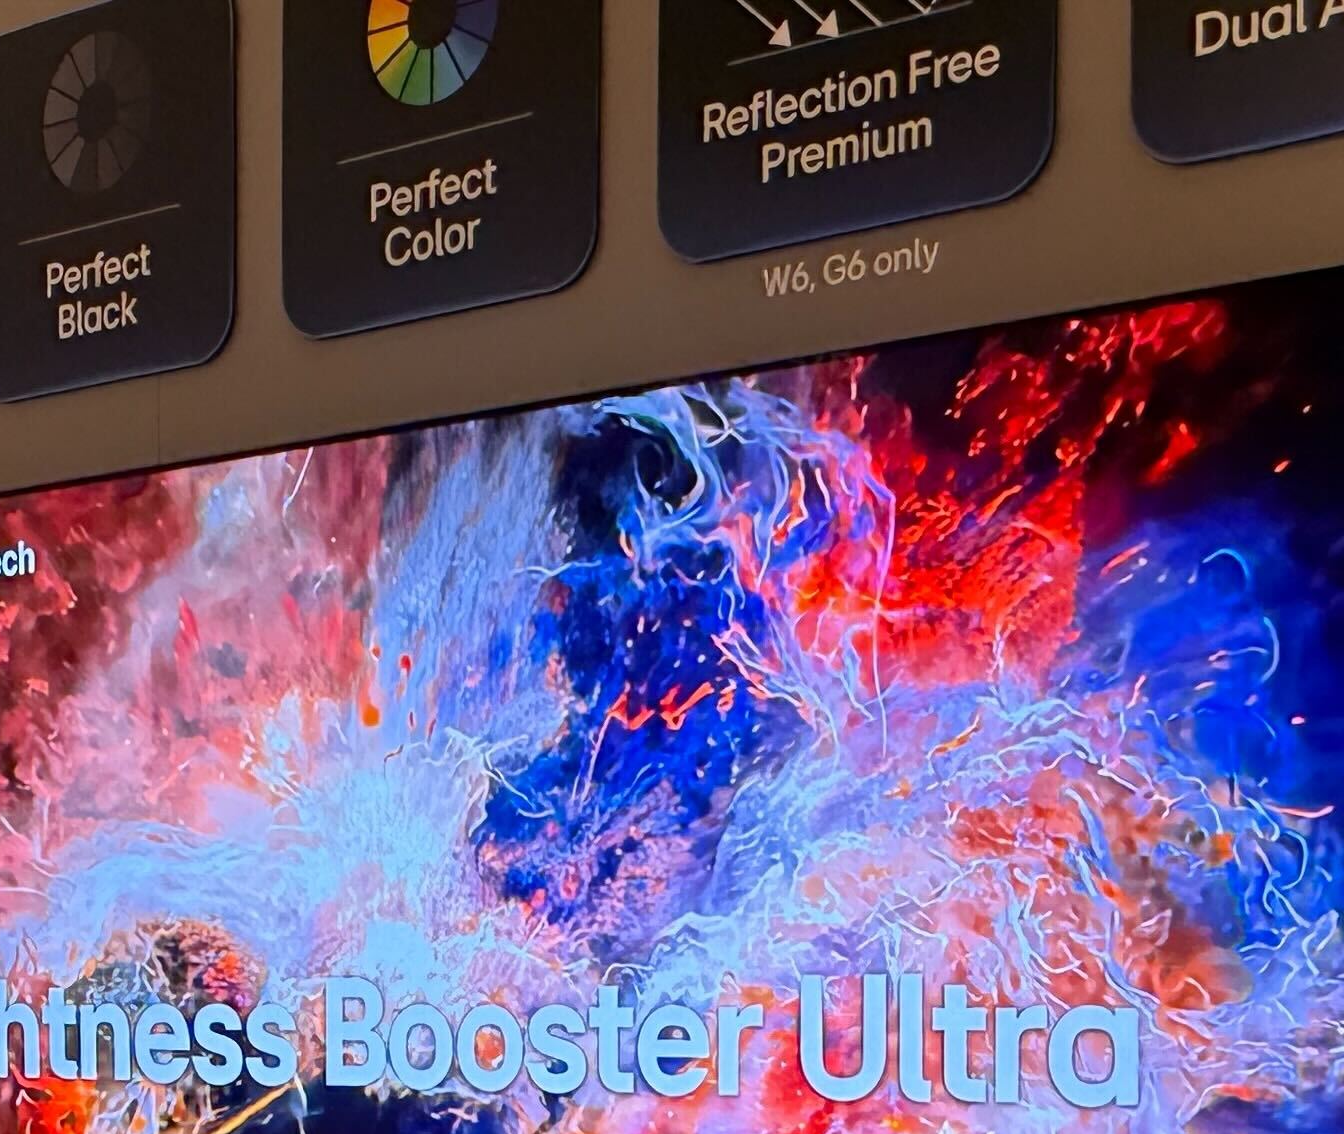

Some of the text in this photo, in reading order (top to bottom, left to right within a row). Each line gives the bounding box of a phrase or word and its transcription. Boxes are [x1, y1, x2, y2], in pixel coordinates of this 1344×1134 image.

[1194, 0, 1307, 57] Dual
[703, 42, 1000, 142] Reflection Free
[761, 115, 933, 183] Premium
[370, 159, 498, 222] Perfect
[385, 216, 481, 266] Color
[763, 238, 940, 297] W6, G6 only
[47, 244, 152, 298] Perfect
[58, 292, 138, 339] Black
[324, 976, 764, 1096] Booster
[796, 974, 1141, 1109] Ultra
